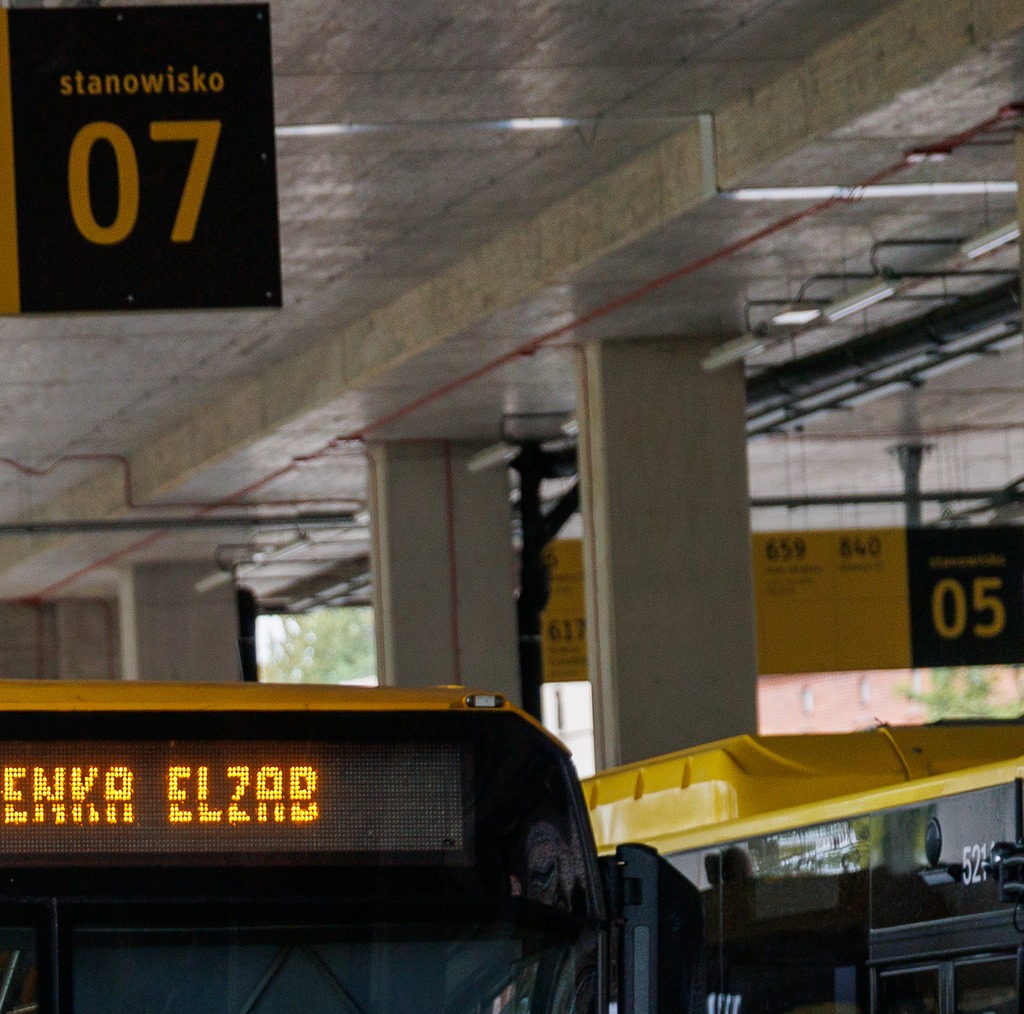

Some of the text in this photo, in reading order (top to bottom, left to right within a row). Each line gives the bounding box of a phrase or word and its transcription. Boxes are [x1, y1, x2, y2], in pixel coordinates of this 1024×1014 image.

[59, 66, 226, 97] stanowisko
[67, 119, 223, 246] 07
[932, 577, 1006, 639] 05
[168, 766, 319, 824] ELZAB
[962, 841, 996, 885] 521
